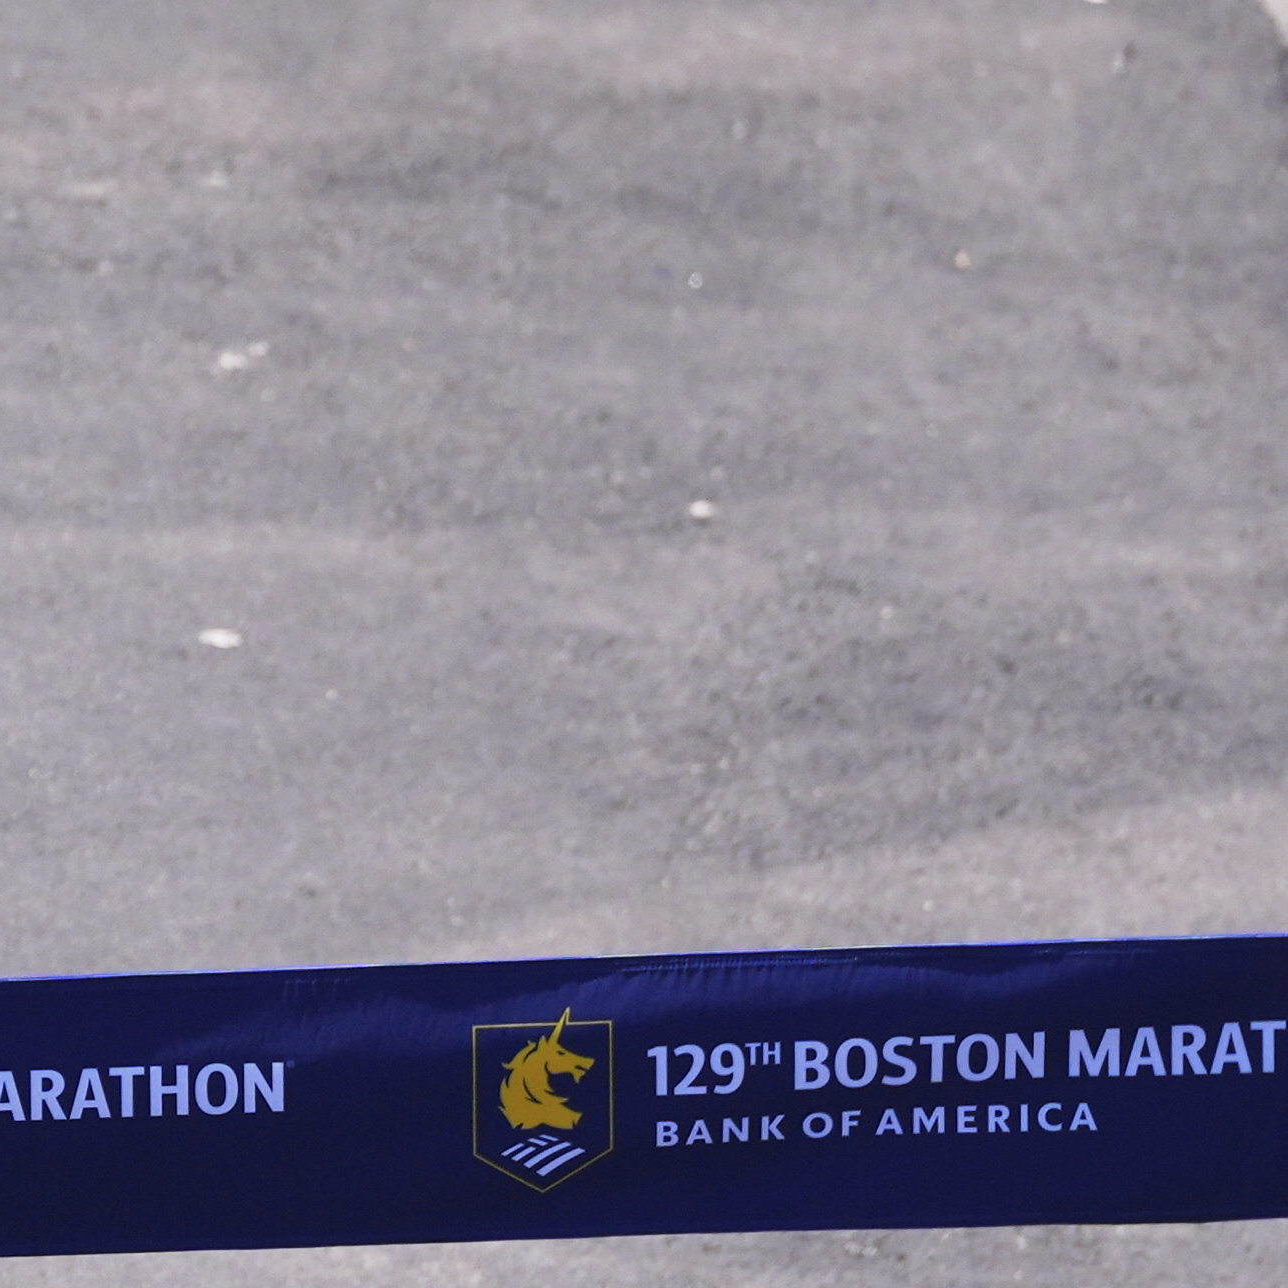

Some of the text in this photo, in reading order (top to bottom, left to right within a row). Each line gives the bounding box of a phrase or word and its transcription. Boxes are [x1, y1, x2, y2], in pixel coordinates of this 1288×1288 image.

[647, 1020, 1288, 1096] 129TH BOSTON MARAT
[656, 1102, 1098, 1147] BANK OF AMERICA
